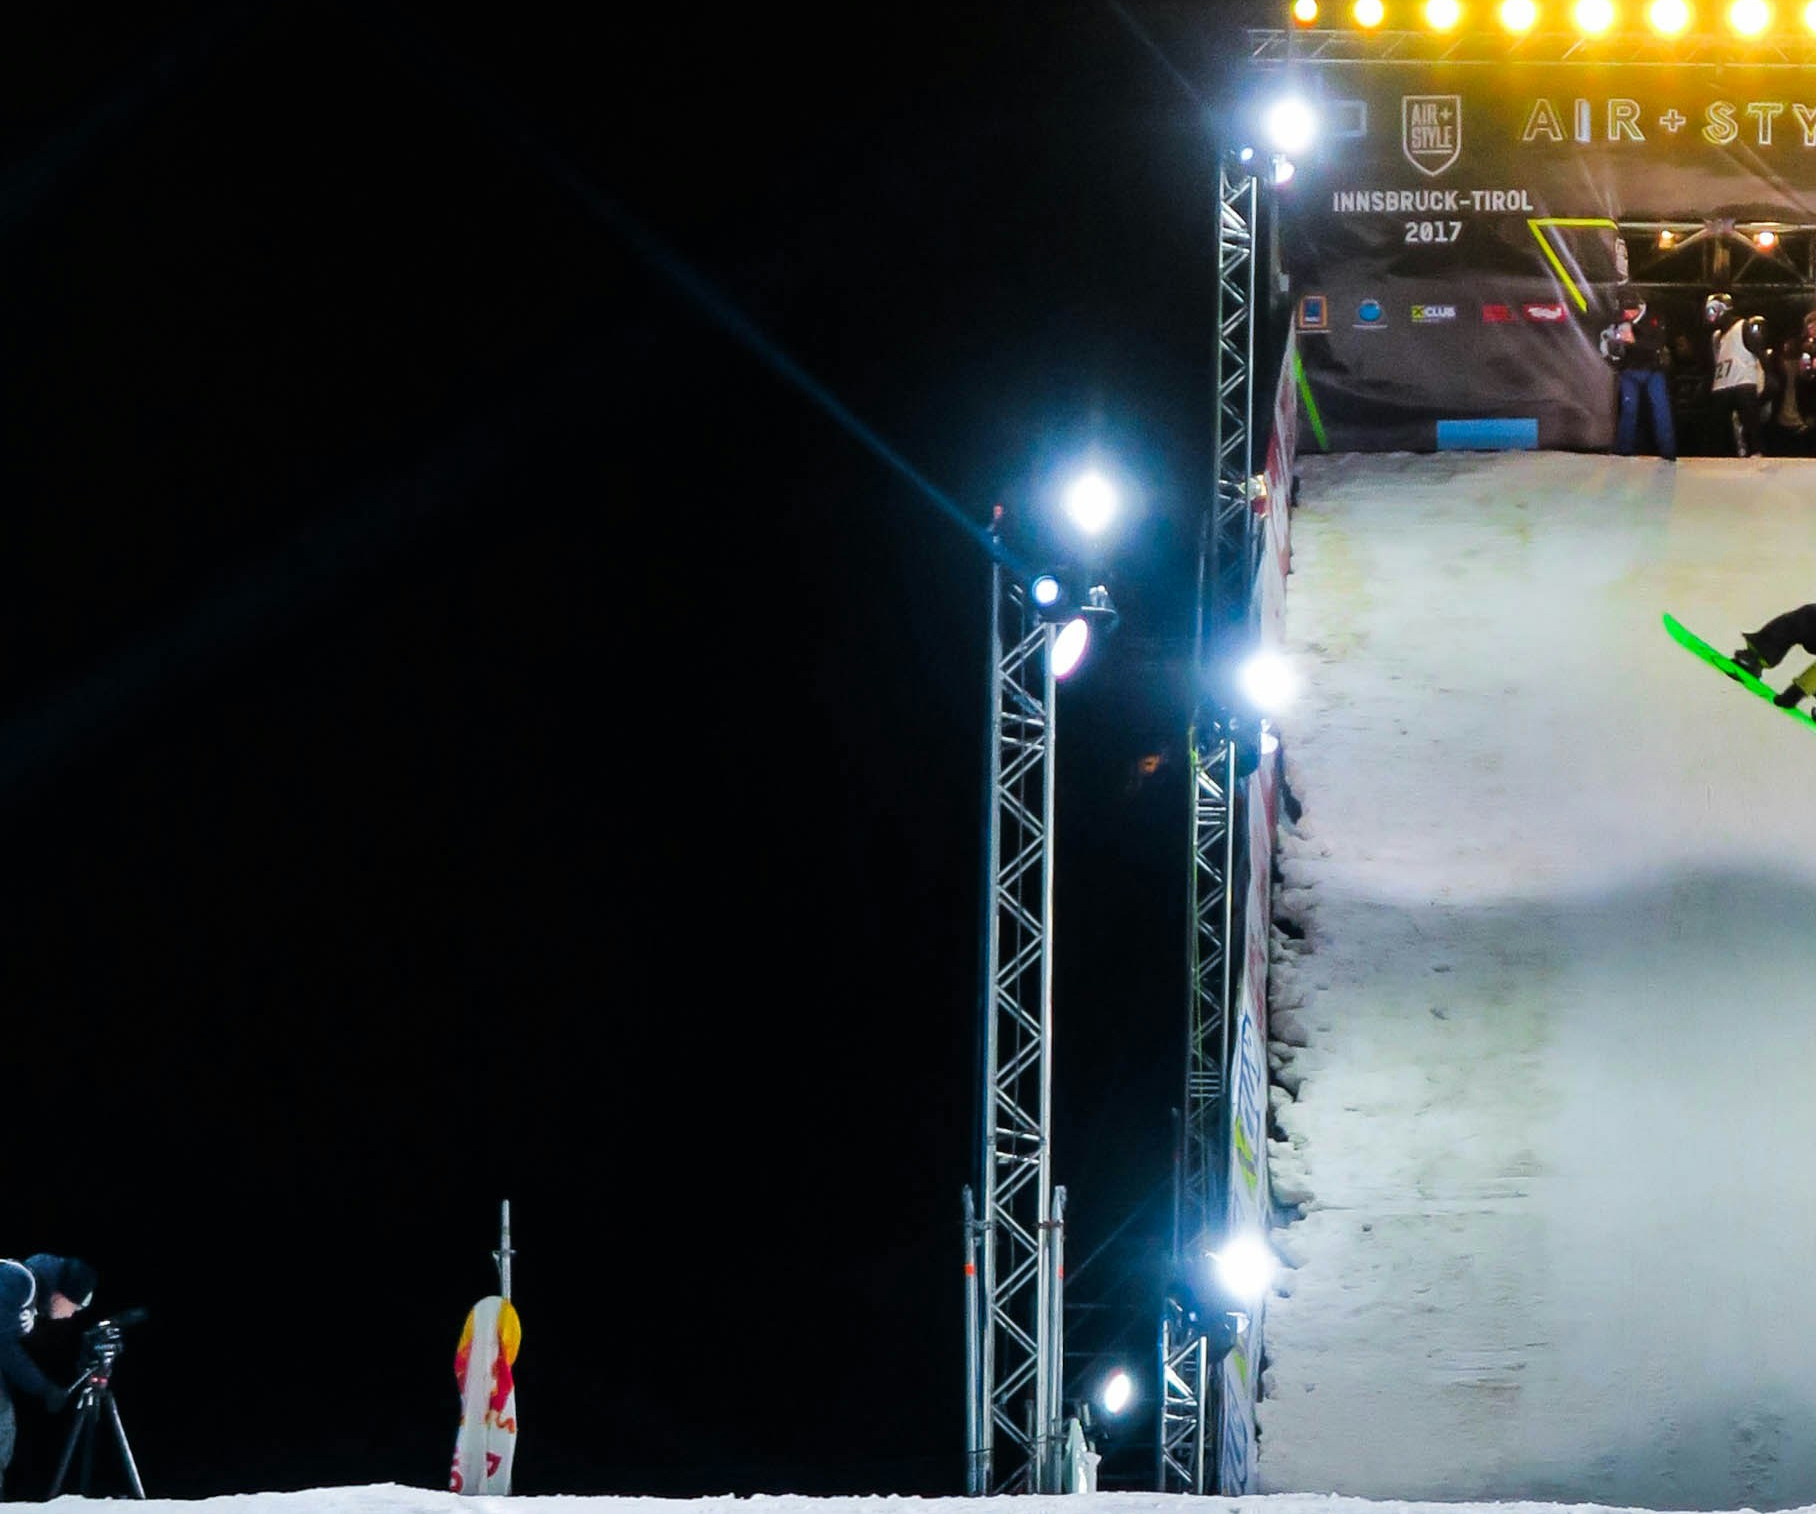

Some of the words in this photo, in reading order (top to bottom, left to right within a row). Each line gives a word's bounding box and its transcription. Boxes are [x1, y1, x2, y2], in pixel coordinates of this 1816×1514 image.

[1411, 126, 1453, 149] STYLE
[1333, 191, 1533, 213] INNSBRUCK-TIROL
[1404, 222, 1462, 243] 2017
